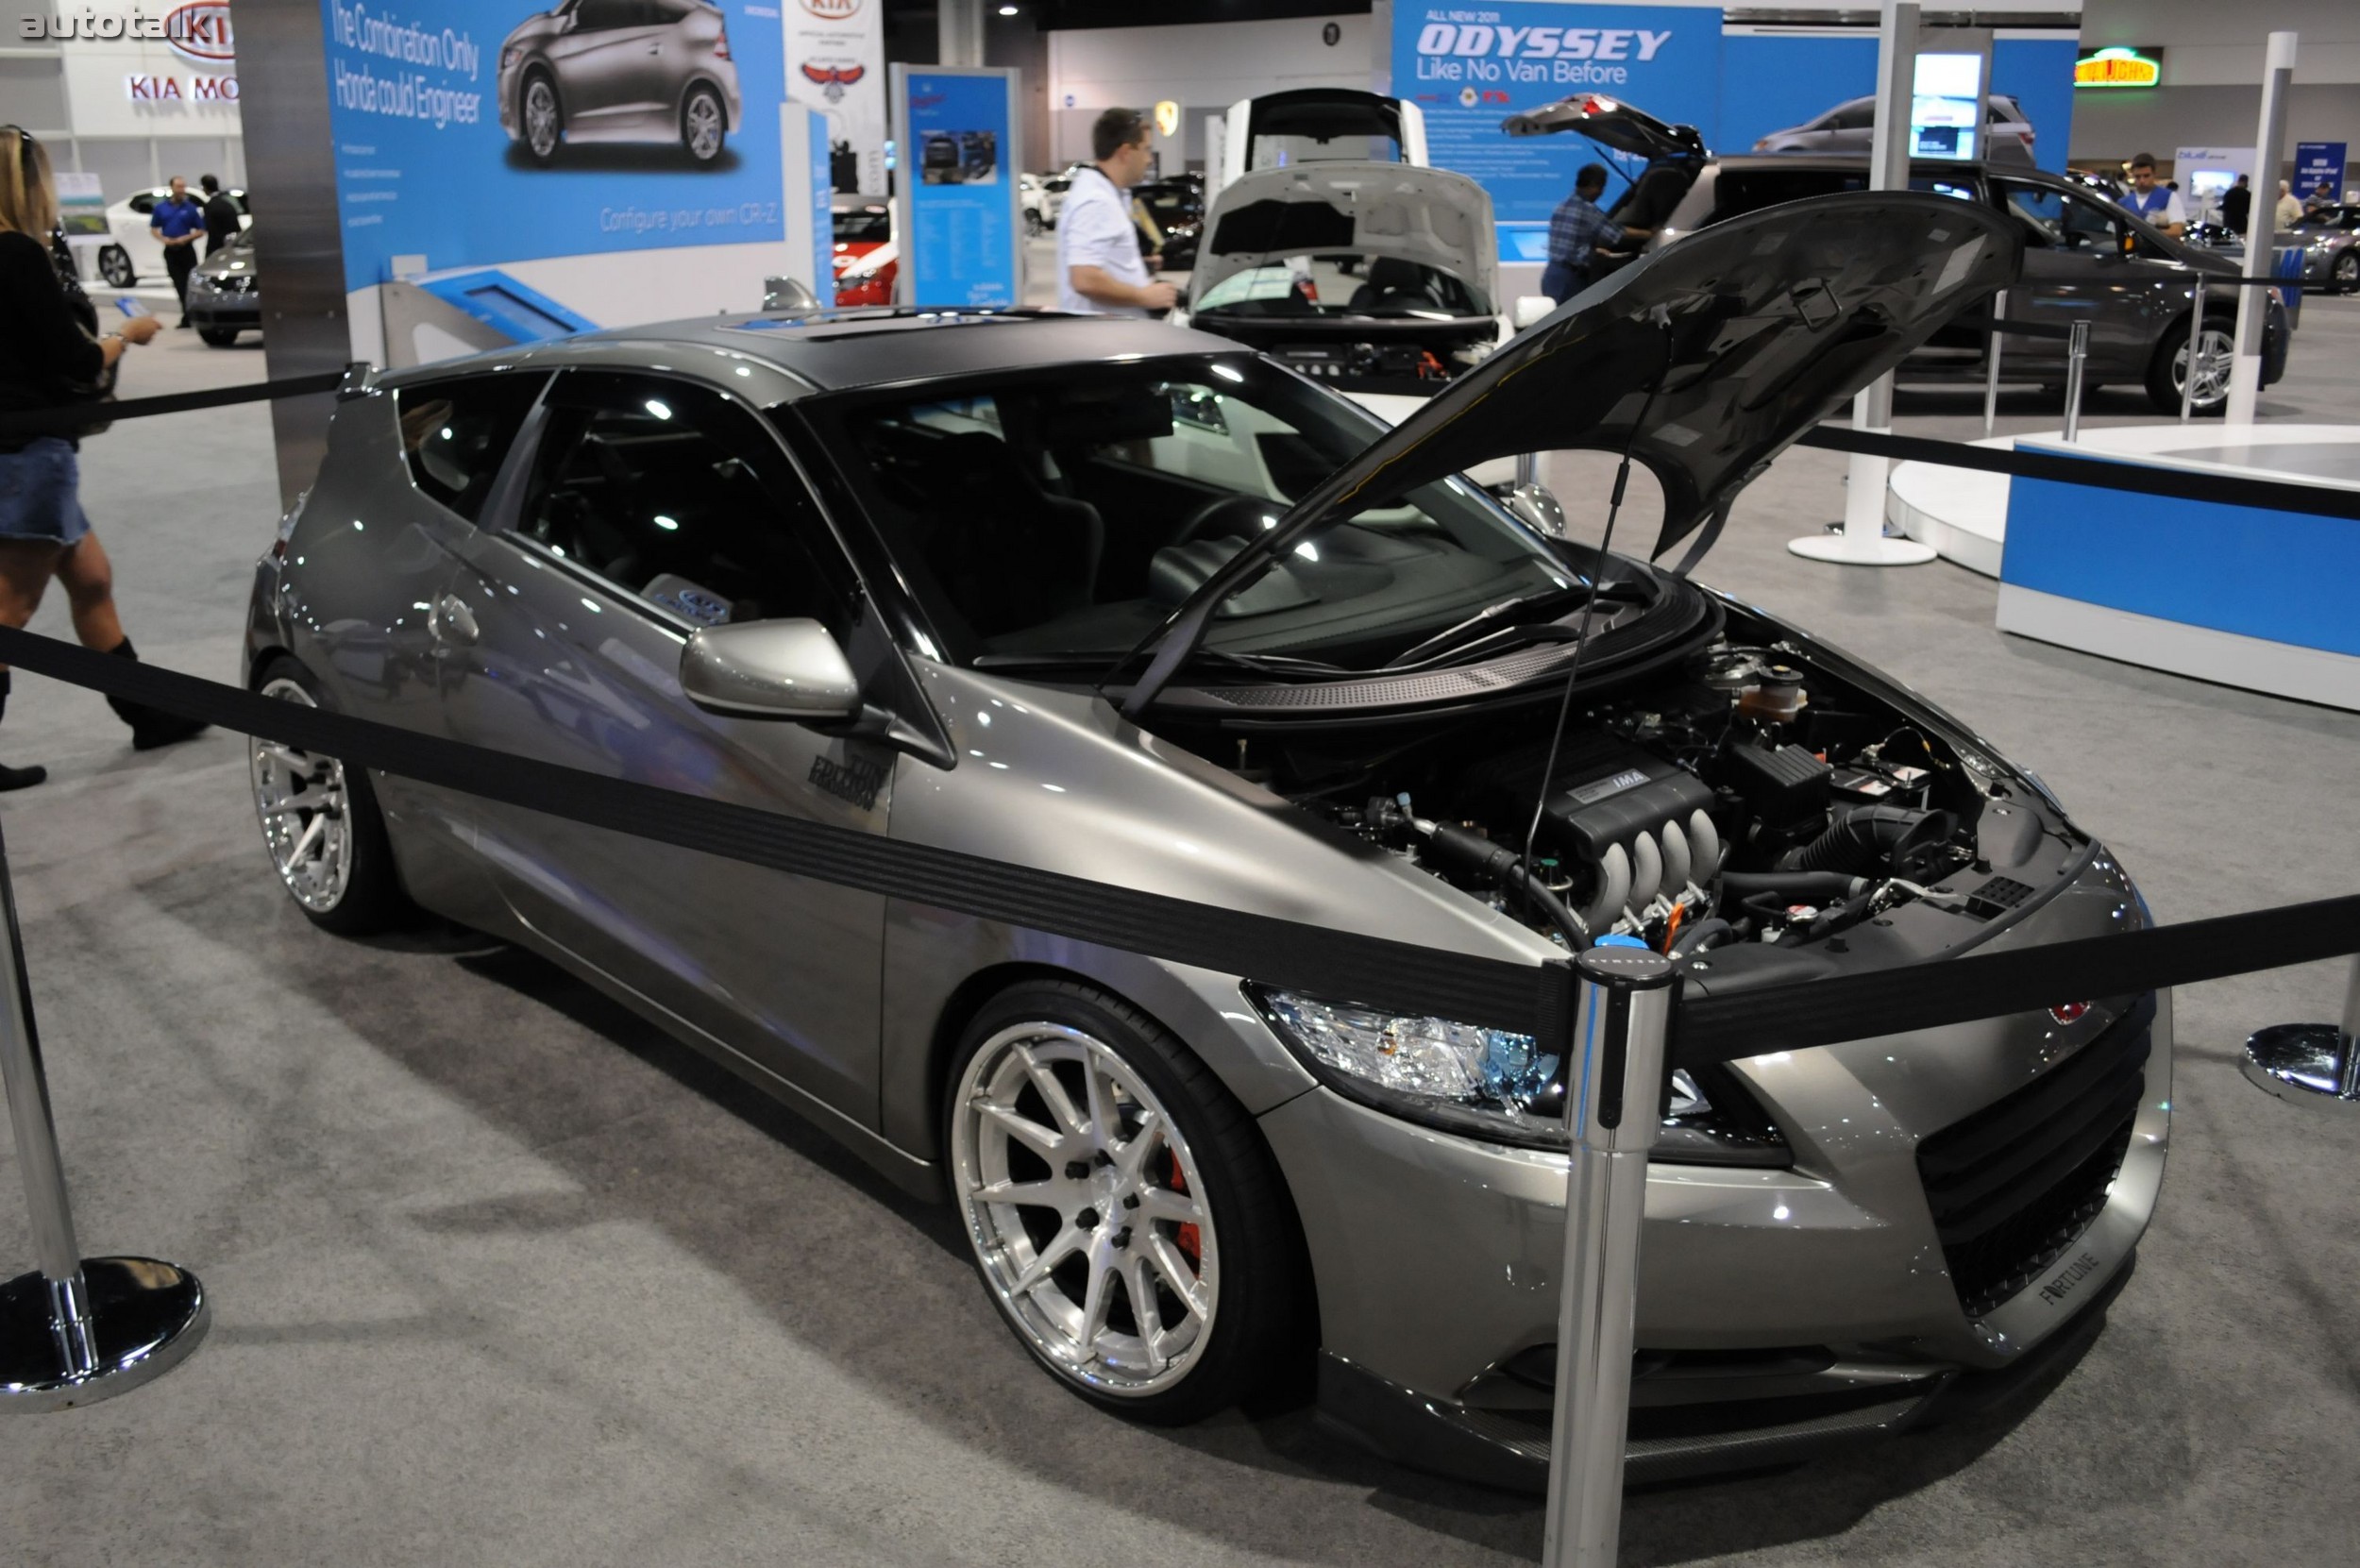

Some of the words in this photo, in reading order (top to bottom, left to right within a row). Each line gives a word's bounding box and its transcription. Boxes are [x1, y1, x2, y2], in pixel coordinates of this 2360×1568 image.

[1426, 9, 1447, 22] ALL
[1448, 10, 1476, 23] NEW
[355, 3, 442, 67] Combination
[442, 27, 480, 82] Only
[1416, 24, 1672, 60] ODYSSEY
[1417, 57, 1462, 80] Like
[1467, 59, 1501, 81] No
[1506, 59, 1548, 82] Van
[1554, 60, 1627, 84] Before
[130, 76, 182, 99] KIA
[194, 76, 239, 100] MO
[334, 58, 377, 112] Honda
[378, 70, 415, 118] could
[415, 75, 481, 129] Engineer
[599, 206, 669, 234] Configure
[670, 209, 702, 232] your
[705, 207, 739, 226] own
[739, 201, 778, 226] CR-Z
[1612, 771, 1644, 788] IMA
